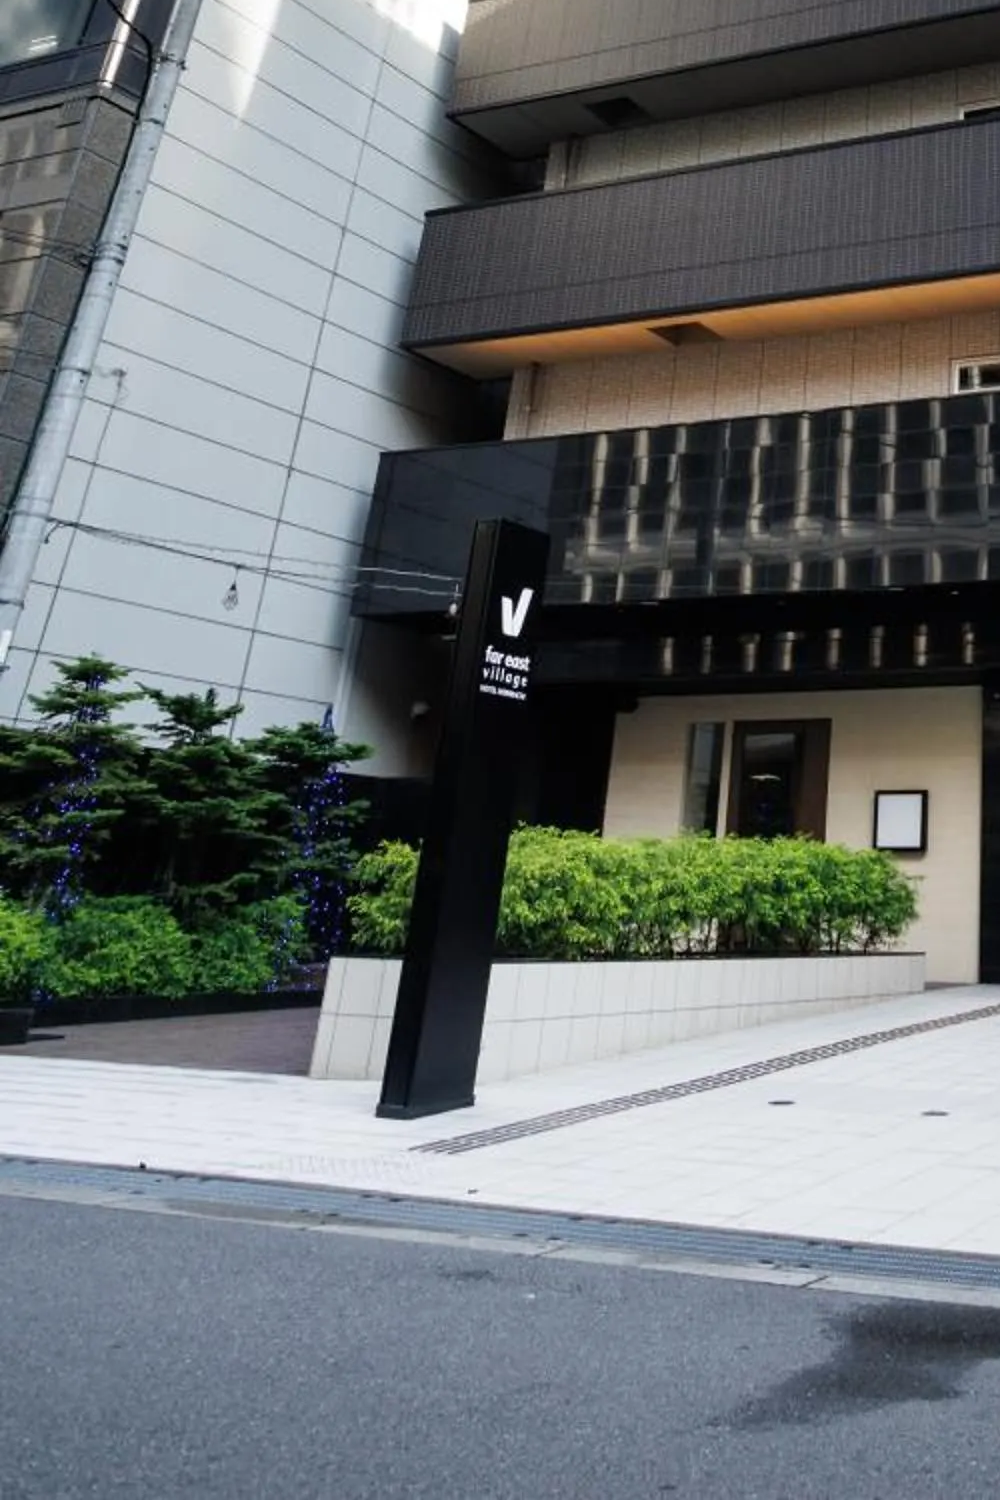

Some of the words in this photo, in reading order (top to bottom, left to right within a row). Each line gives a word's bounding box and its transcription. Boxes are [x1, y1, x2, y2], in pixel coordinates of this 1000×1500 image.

[485, 644, 505, 665] far
[504, 654, 530, 672] east
[483, 665, 529, 689] village
